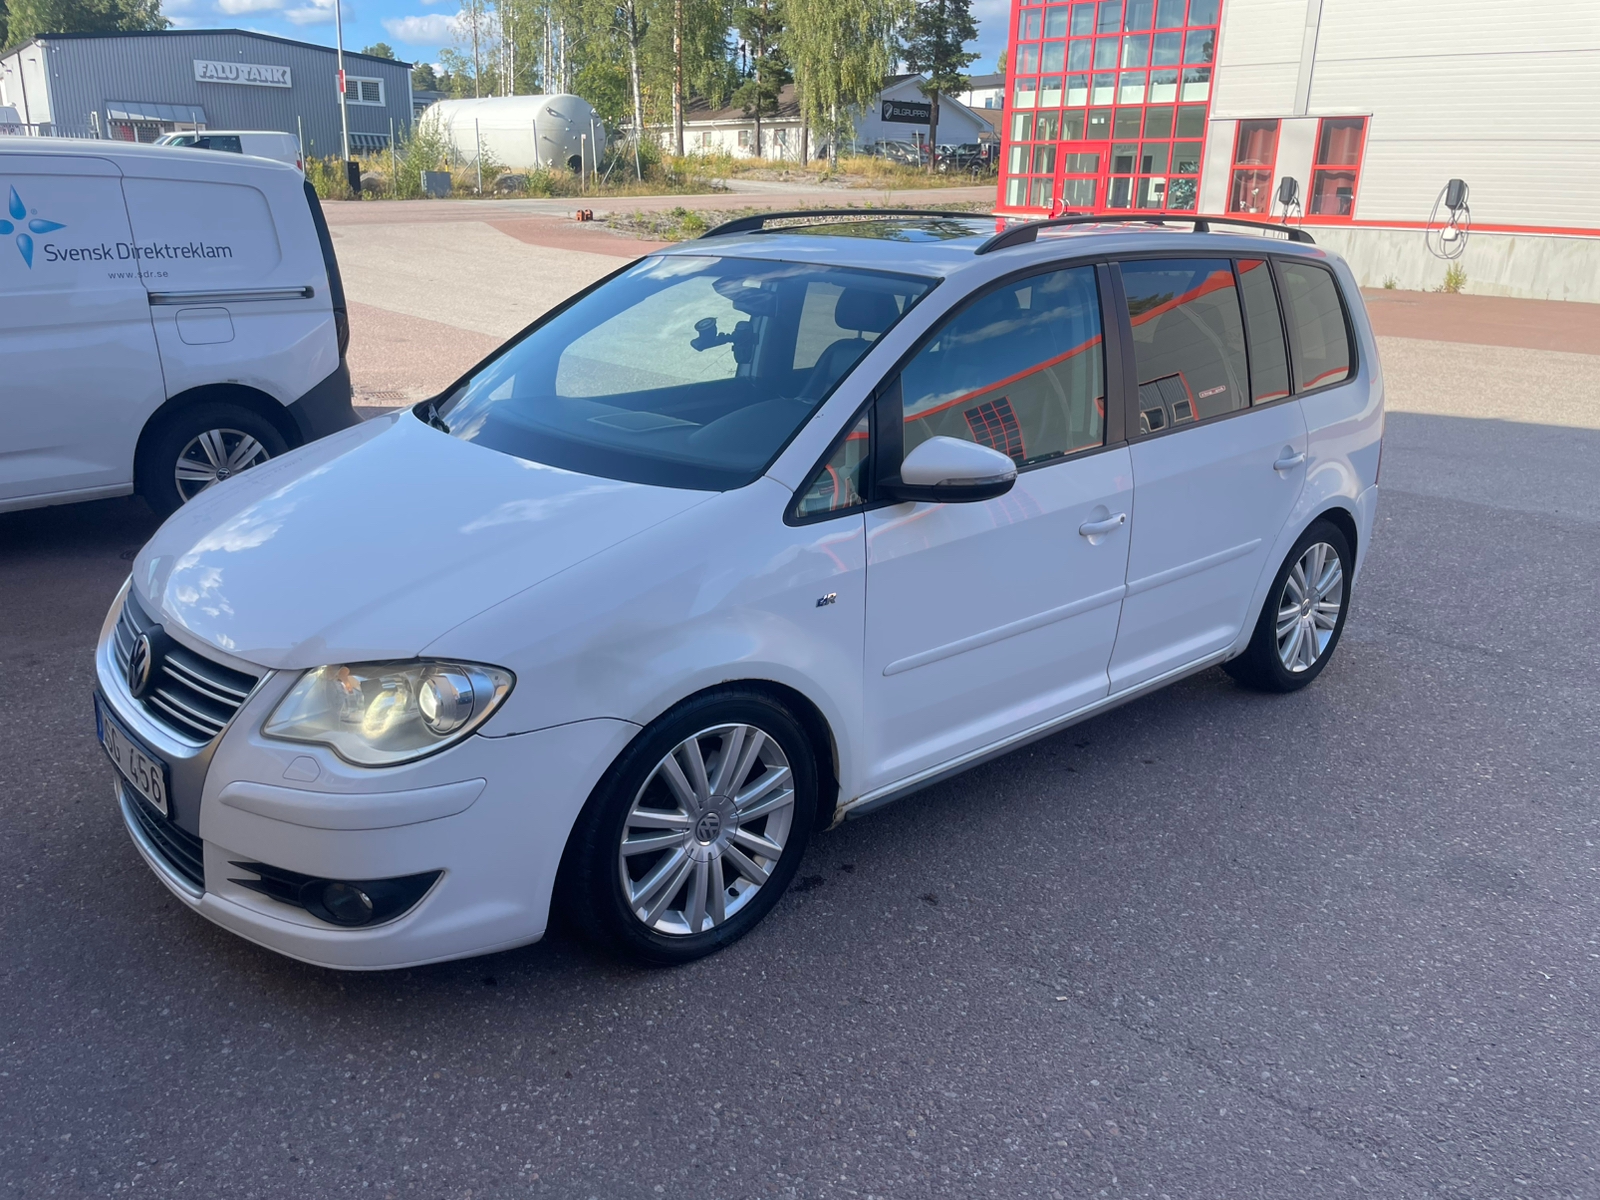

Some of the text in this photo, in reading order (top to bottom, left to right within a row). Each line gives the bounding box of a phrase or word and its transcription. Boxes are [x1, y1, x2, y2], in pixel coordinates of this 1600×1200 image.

[197, 62, 288, 84] FALU TANK
[893, 107, 930, 118] BILGRUPPEN
[44, 242, 233, 262] Svensk Direktreklam
[108, 270, 169, 279] www.sdr.se
